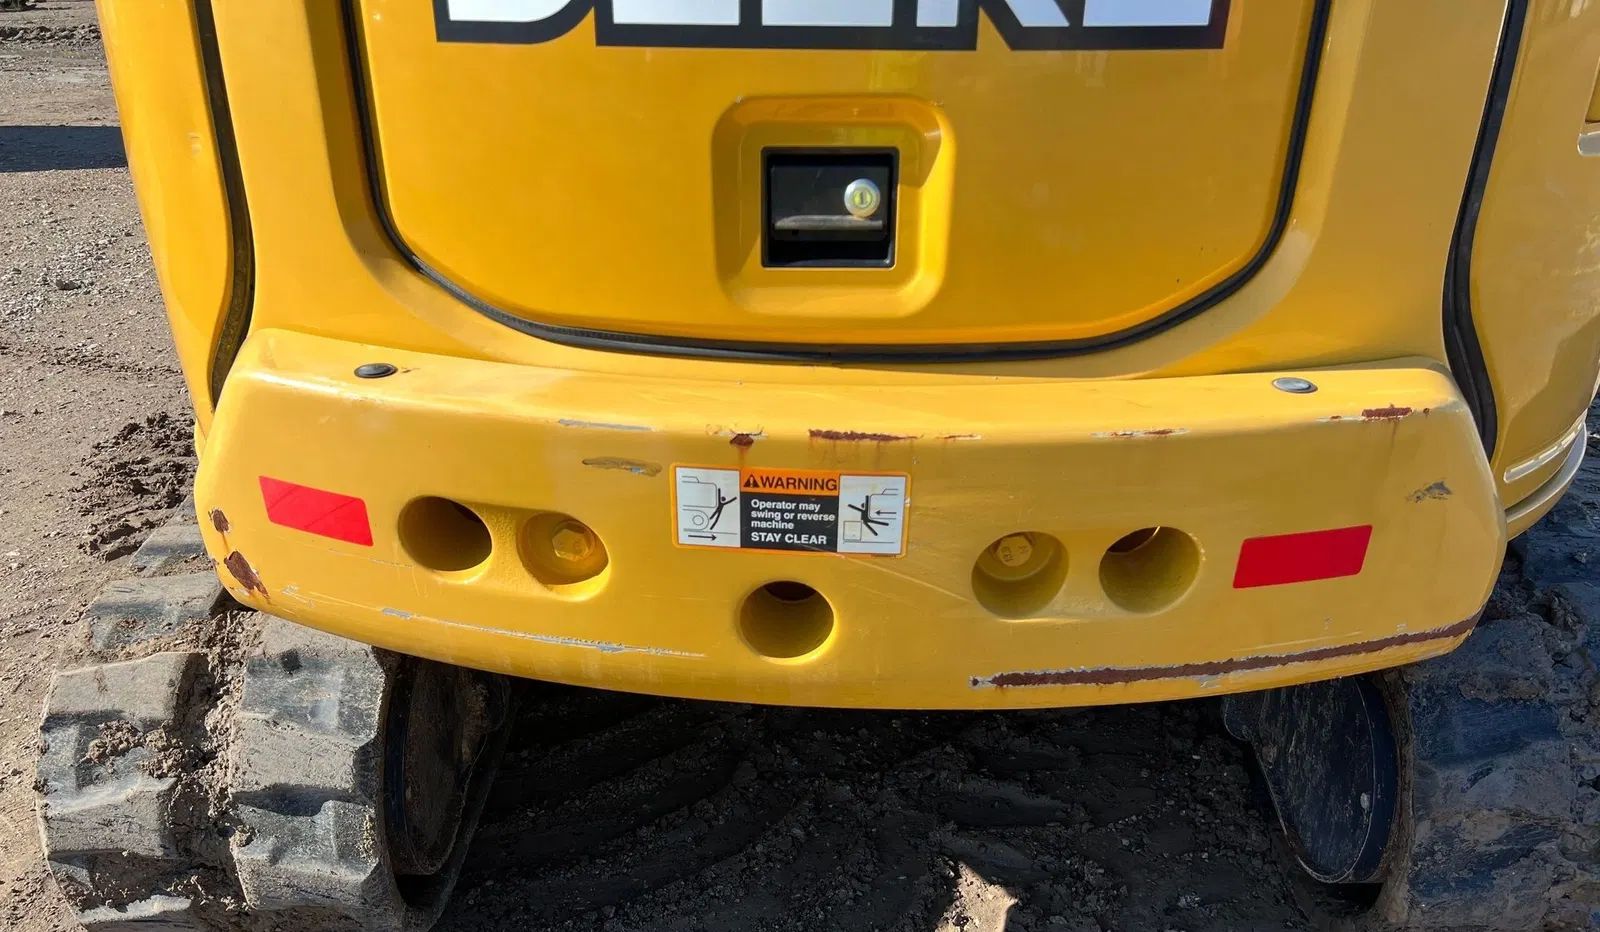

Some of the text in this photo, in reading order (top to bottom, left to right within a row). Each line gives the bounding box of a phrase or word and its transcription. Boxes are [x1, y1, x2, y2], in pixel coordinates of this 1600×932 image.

[760, 476, 837, 491] WARNING
[751, 499, 820, 512] Operator may
[751, 510, 835, 521] swing or reverse
[751, 520, 794, 529] machine
[751, 532, 827, 545] STAY CLEAR
